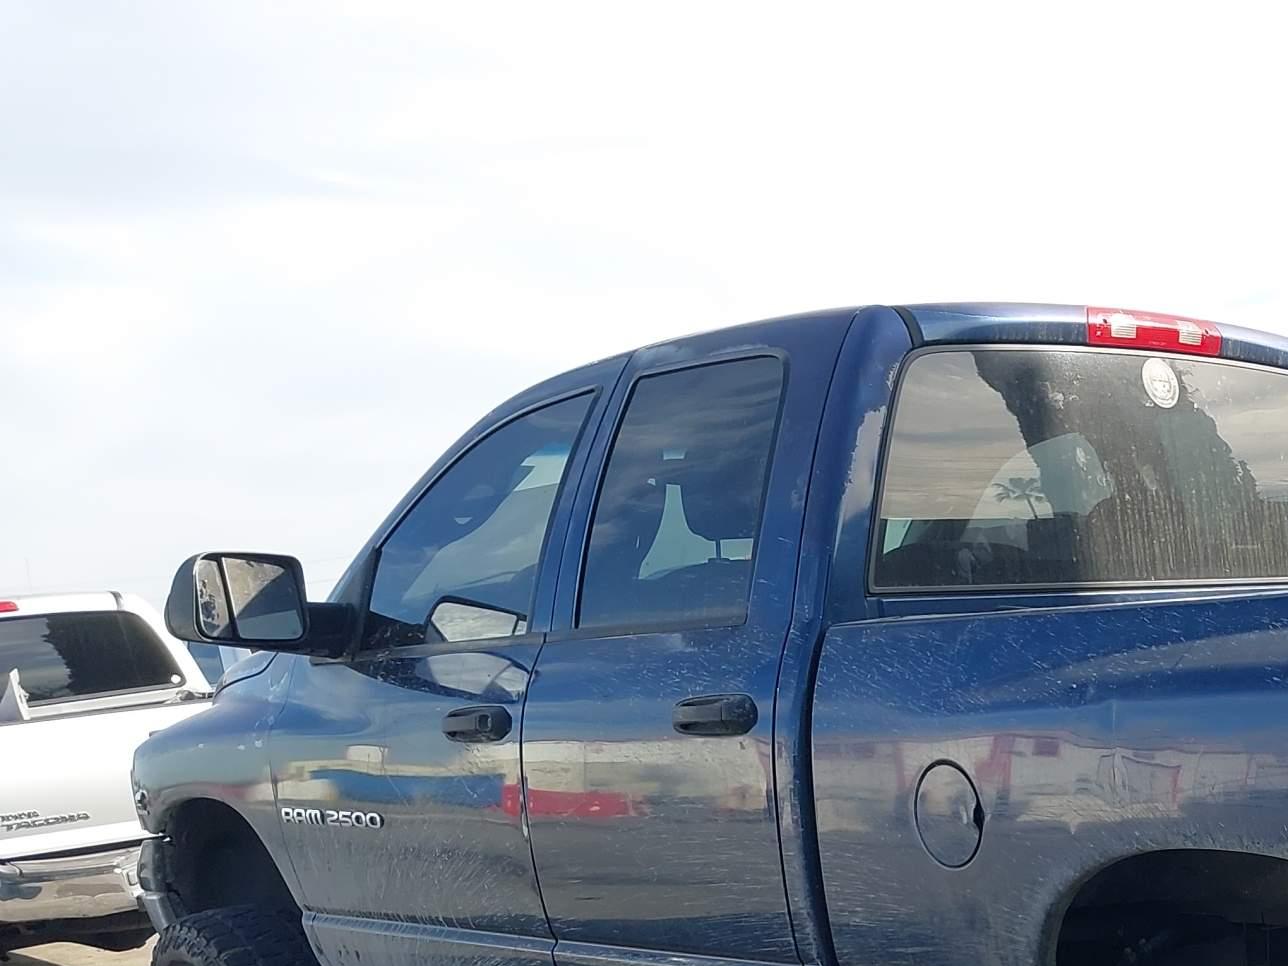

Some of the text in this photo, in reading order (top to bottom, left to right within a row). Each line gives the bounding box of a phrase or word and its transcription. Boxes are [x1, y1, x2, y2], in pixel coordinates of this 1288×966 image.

[0, 812, 90, 832] TACOMA
[281, 807, 384, 829] RAM 2500
